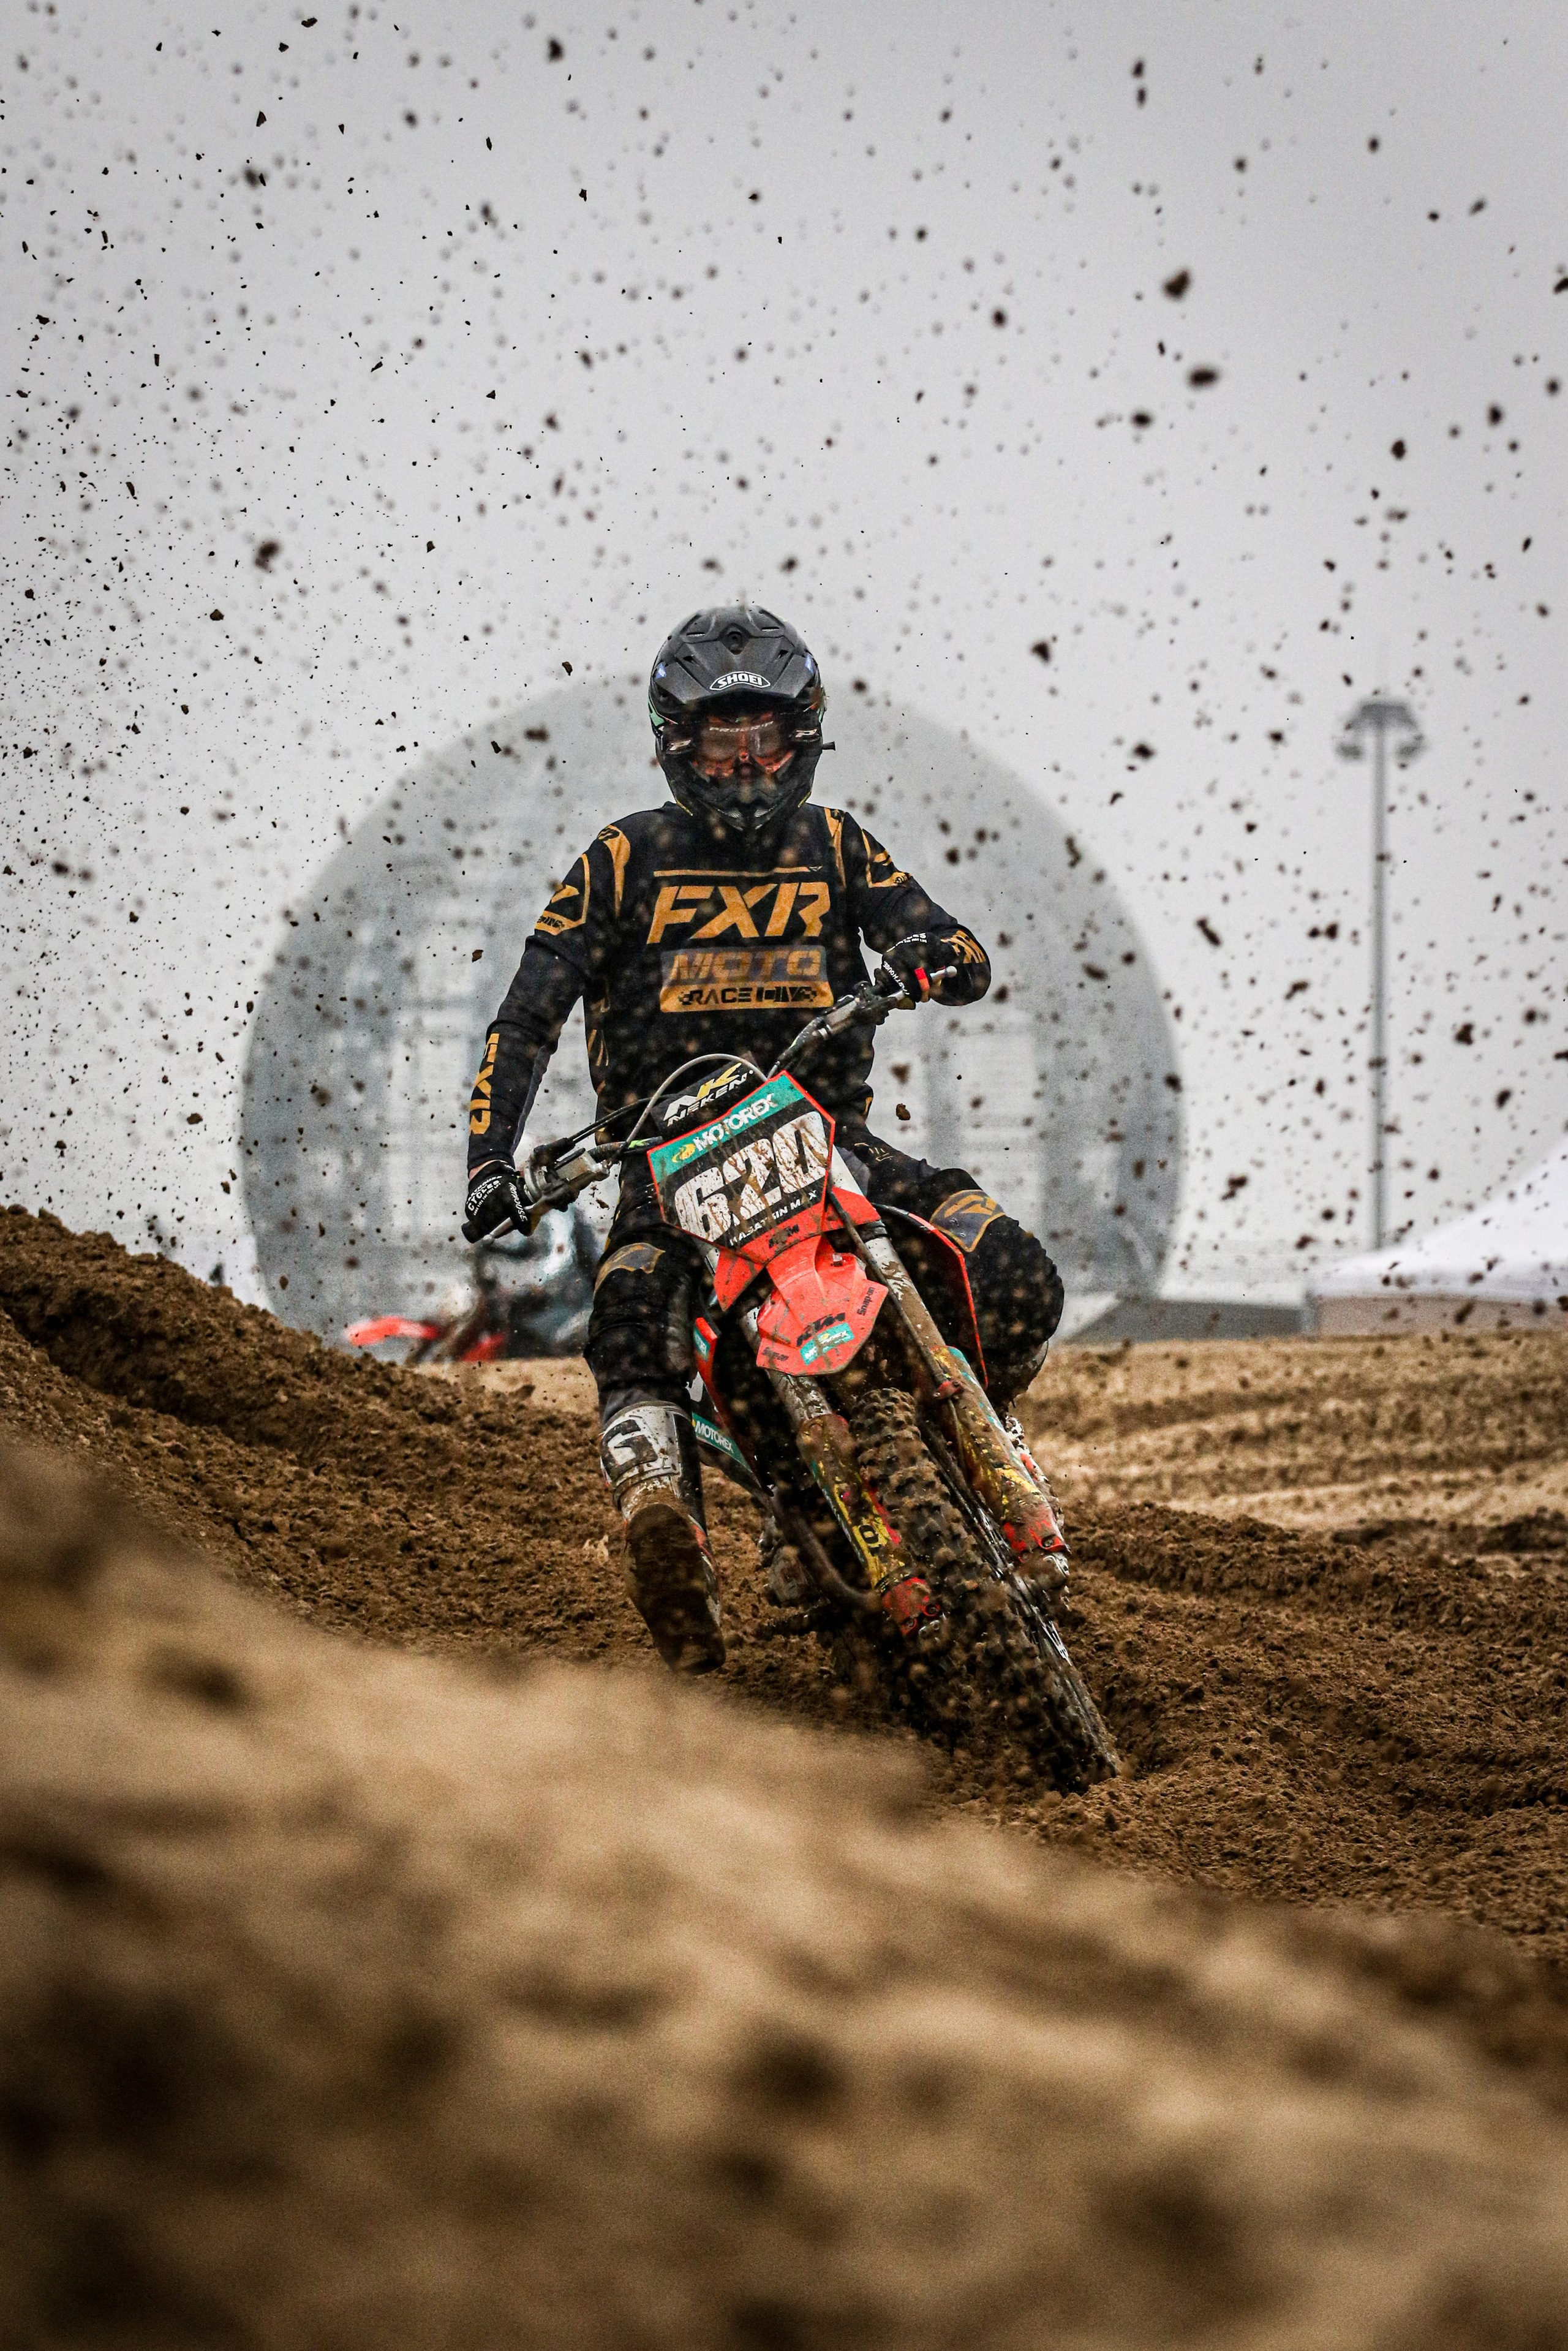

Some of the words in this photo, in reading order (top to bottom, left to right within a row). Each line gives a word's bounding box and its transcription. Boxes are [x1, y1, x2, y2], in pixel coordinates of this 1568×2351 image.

[717, 672, 762, 688] SHOEI
[647, 882, 831, 944] FXR
[671, 950, 821, 979] MOTO
[689, 987, 753, 1005] RACE
[667, 1073, 748, 1126] NEKEN
[693, 1093, 778, 1152] MOTOREX
[674, 1111, 829, 1242] 620
[467, 1180, 500, 1212] CYCLES
[790, 1190, 817, 1210] MX
[856, 1286, 875, 1316] Snap-on
[695, 1421, 734, 1454] MOTOREX
